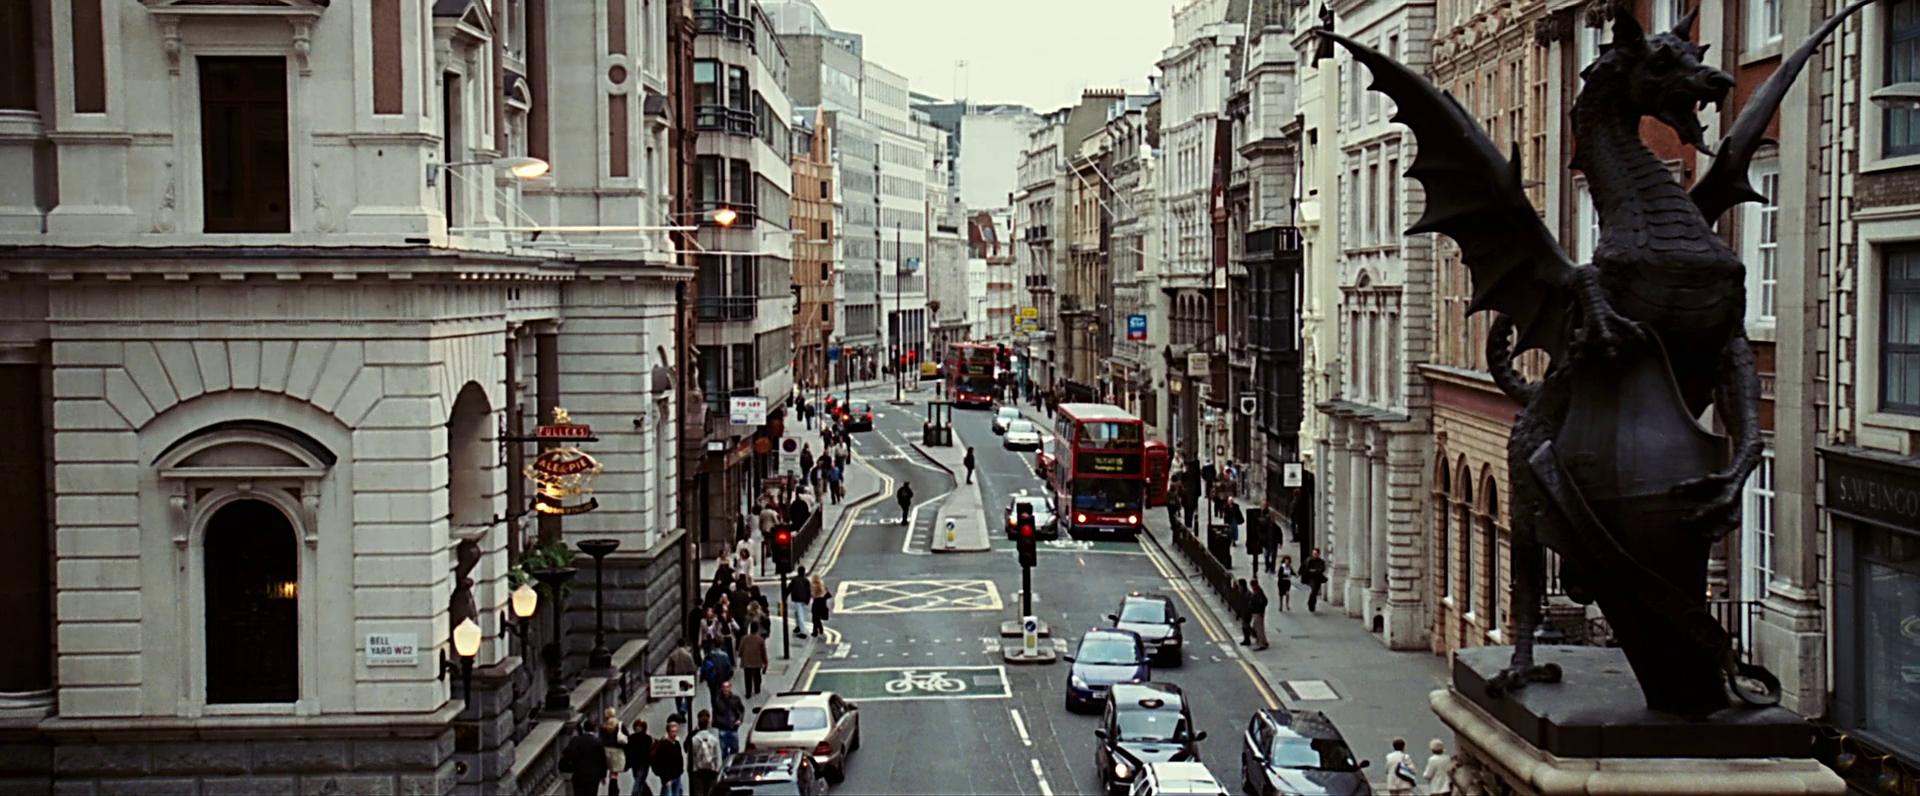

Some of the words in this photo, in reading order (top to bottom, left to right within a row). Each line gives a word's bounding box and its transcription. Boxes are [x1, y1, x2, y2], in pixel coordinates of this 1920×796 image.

[538, 460, 560, 472] ALE
[568, 459, 587, 472] PIE
[370, 636, 389, 645] BELL
[371, 646, 392, 655] YARD
[394, 646, 413, 655] WC2
